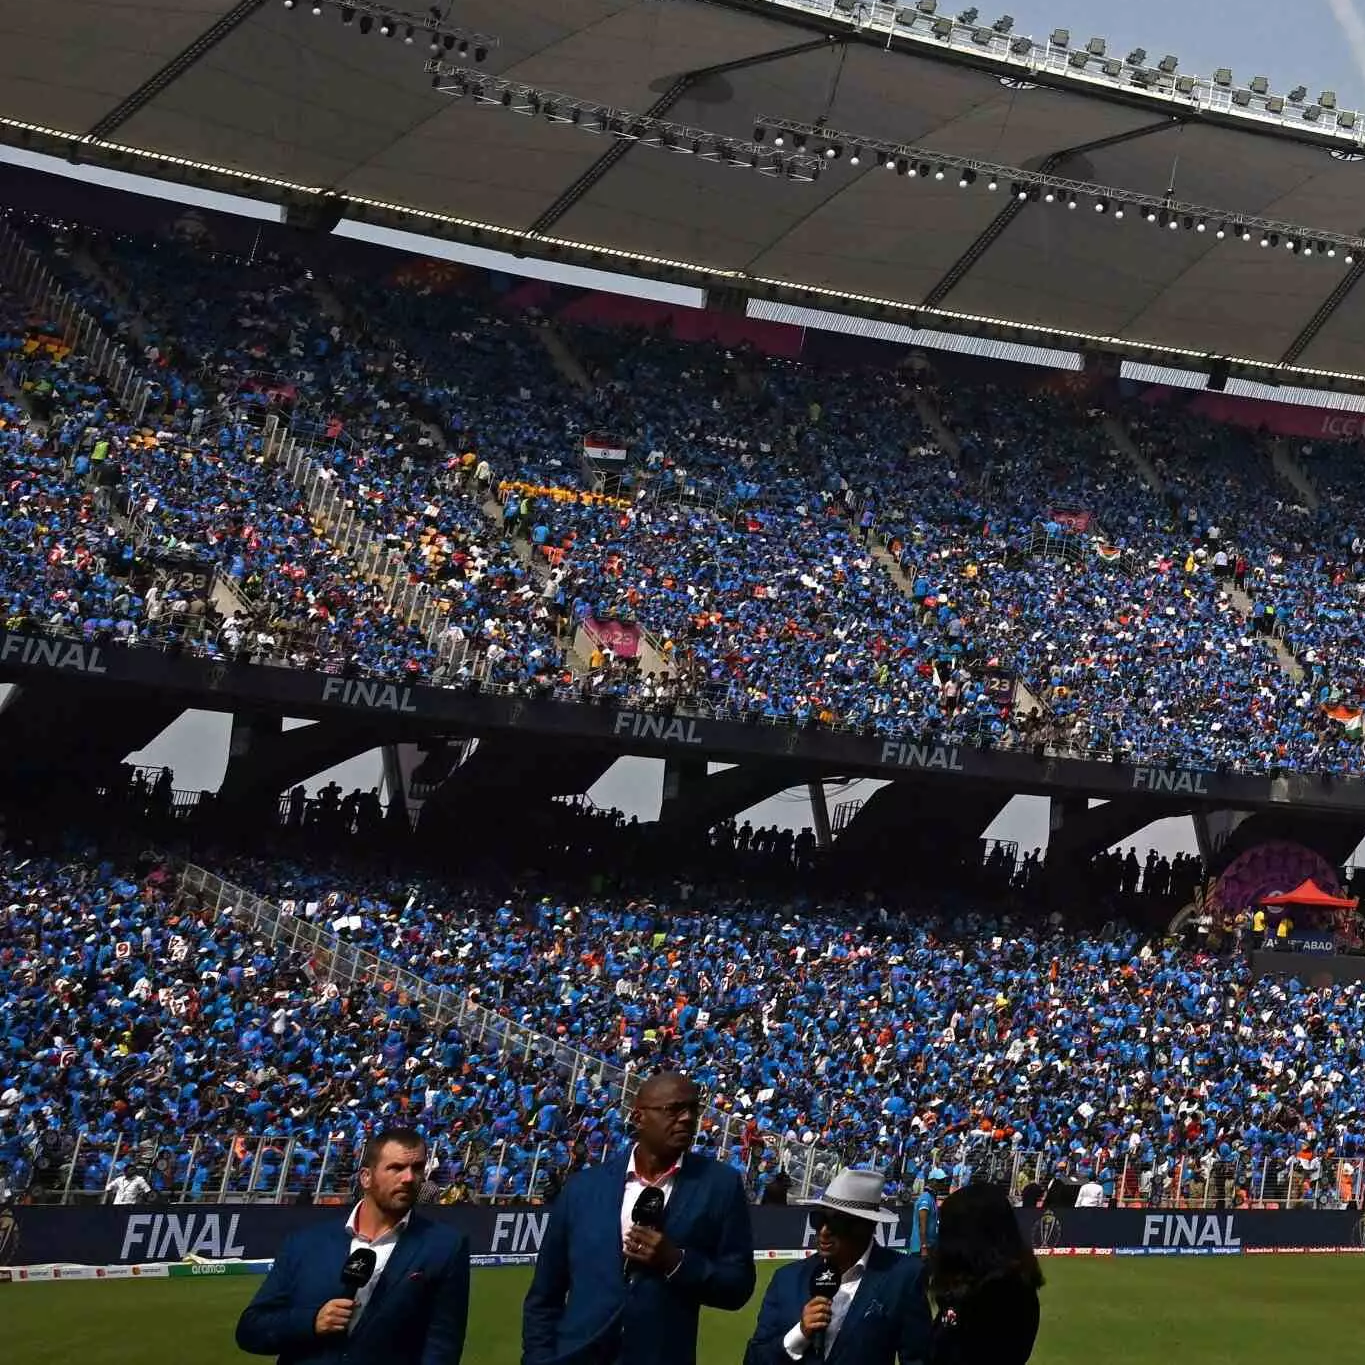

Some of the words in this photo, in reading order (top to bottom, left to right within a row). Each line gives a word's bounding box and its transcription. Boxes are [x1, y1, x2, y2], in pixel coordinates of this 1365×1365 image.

[1321, 416, 1353, 434] ICC
[2, 634, 107, 673] FINAL
[322, 677, 417, 712] FINAL
[614, 713, 703, 744] FINAL
[881, 741, 964, 771] FINAL
[1131, 767, 1209, 794] FINAL
[119, 1213, 247, 1260] FINAL
[1142, 1214, 1241, 1246] FINAL
[191, 1264, 226, 1276] aramco
